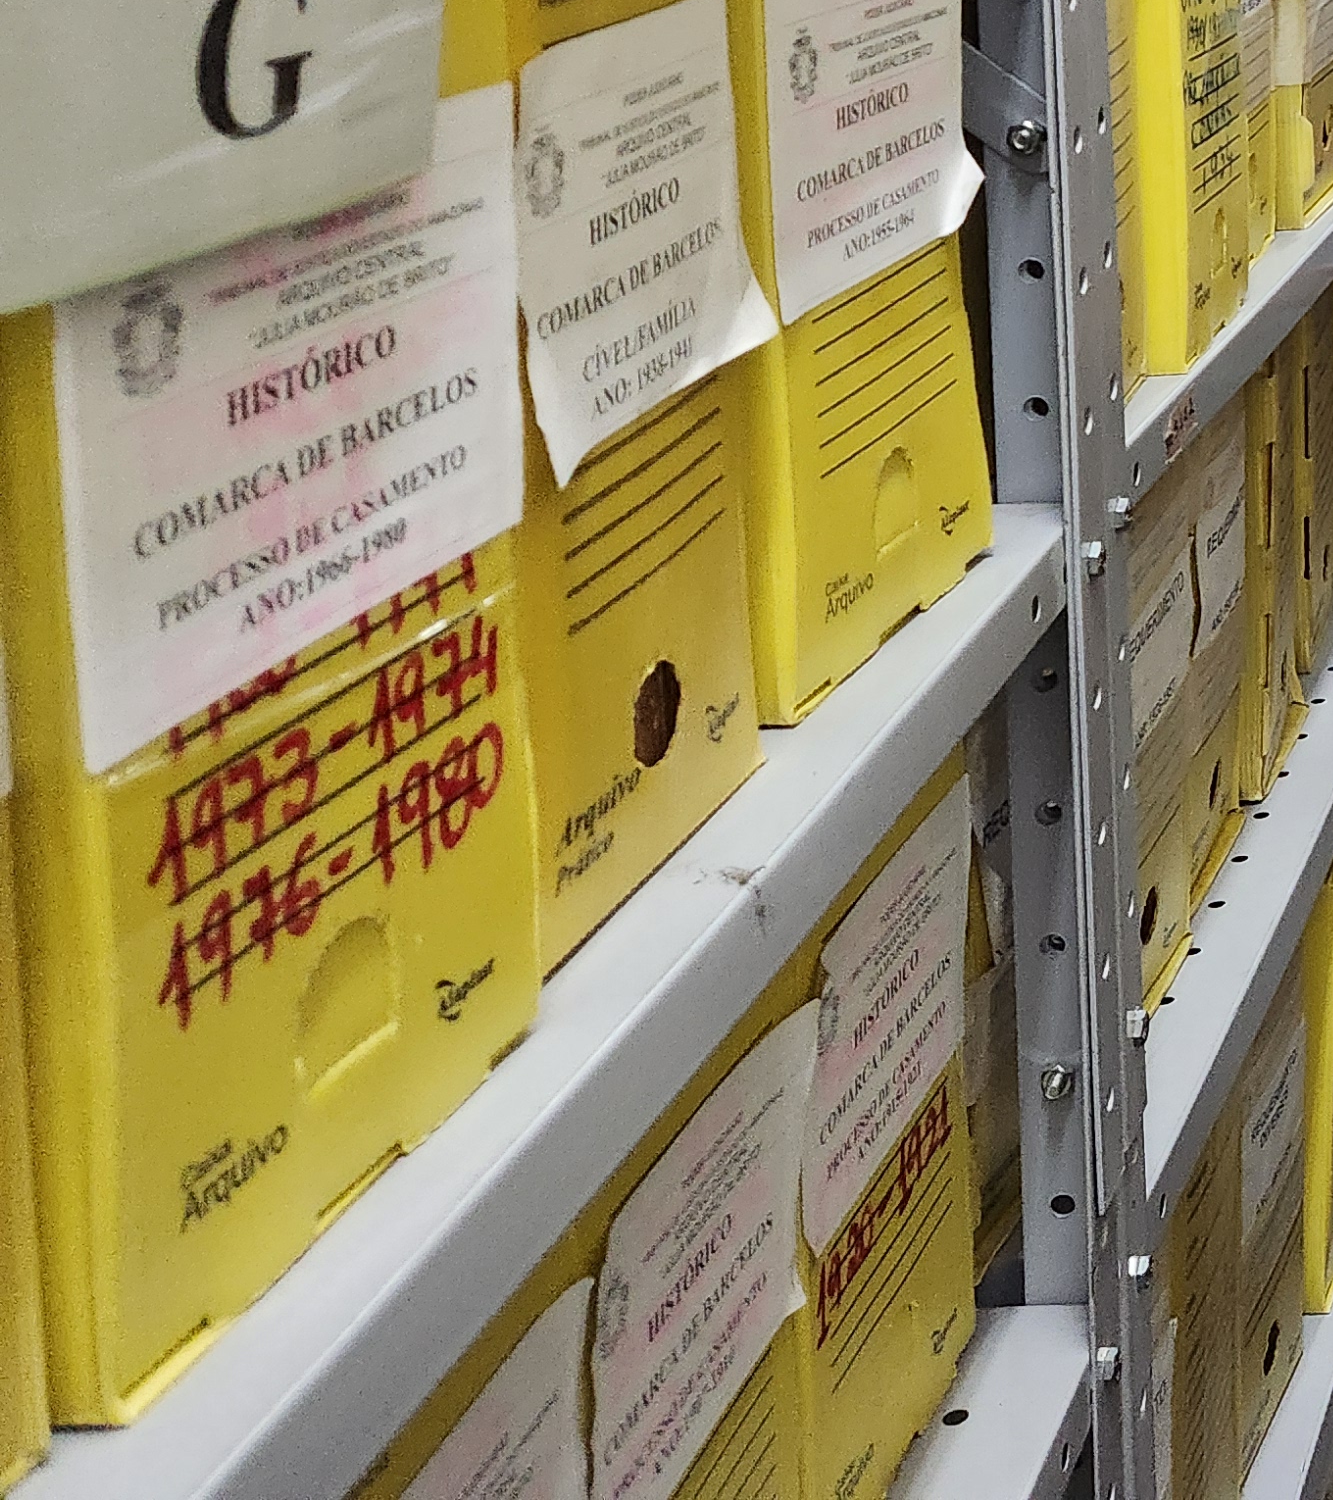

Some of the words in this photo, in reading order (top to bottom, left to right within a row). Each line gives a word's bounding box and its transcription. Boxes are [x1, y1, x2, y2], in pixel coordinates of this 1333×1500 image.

[836, 81, 910, 131] HISTÓRICO
[796, 153, 866, 202] COMARCA
[866, 145, 882, 170] DE
[885, 118, 945, 163] BARCELOS
[588, 176, 681, 248] HISTÓRICO
[807, 201, 864, 249] PROCESSO
[866, 196, 880, 218] DE
[882, 169, 939, 208] CASAMENTO
[536, 279, 626, 340] COMARCA
[629, 262, 650, 293] DE
[652, 217, 722, 280] BARCELOS
[224, 324, 397, 427] HISTÓRICO
[582, 295, 697, 383] CÍVEL/FAMÍLIA
[593, 374, 633, 420] ANO:
[132, 460, 292, 562] COMARCA
[296, 434, 334, 478] DE
[340, 366, 479, 459] BARCELOS
[155, 536, 290, 632] PROCESSO
[296, 522, 322, 554] DE
[329, 445, 468, 537] CASAMENTO
[825, 573, 875, 623] Arquivo
[146, 615, 498, 904] 1973-1974
[556, 766, 642, 856] Arquivo
[157, 722, 503, 1032] 1976-1980
[852, 948, 920, 1050] HISTÓRICO
[819, 1055, 878, 1146] COMARCA
[879, 1034, 895, 1062] DE
[895, 949, 951, 1038] BARCELOS
